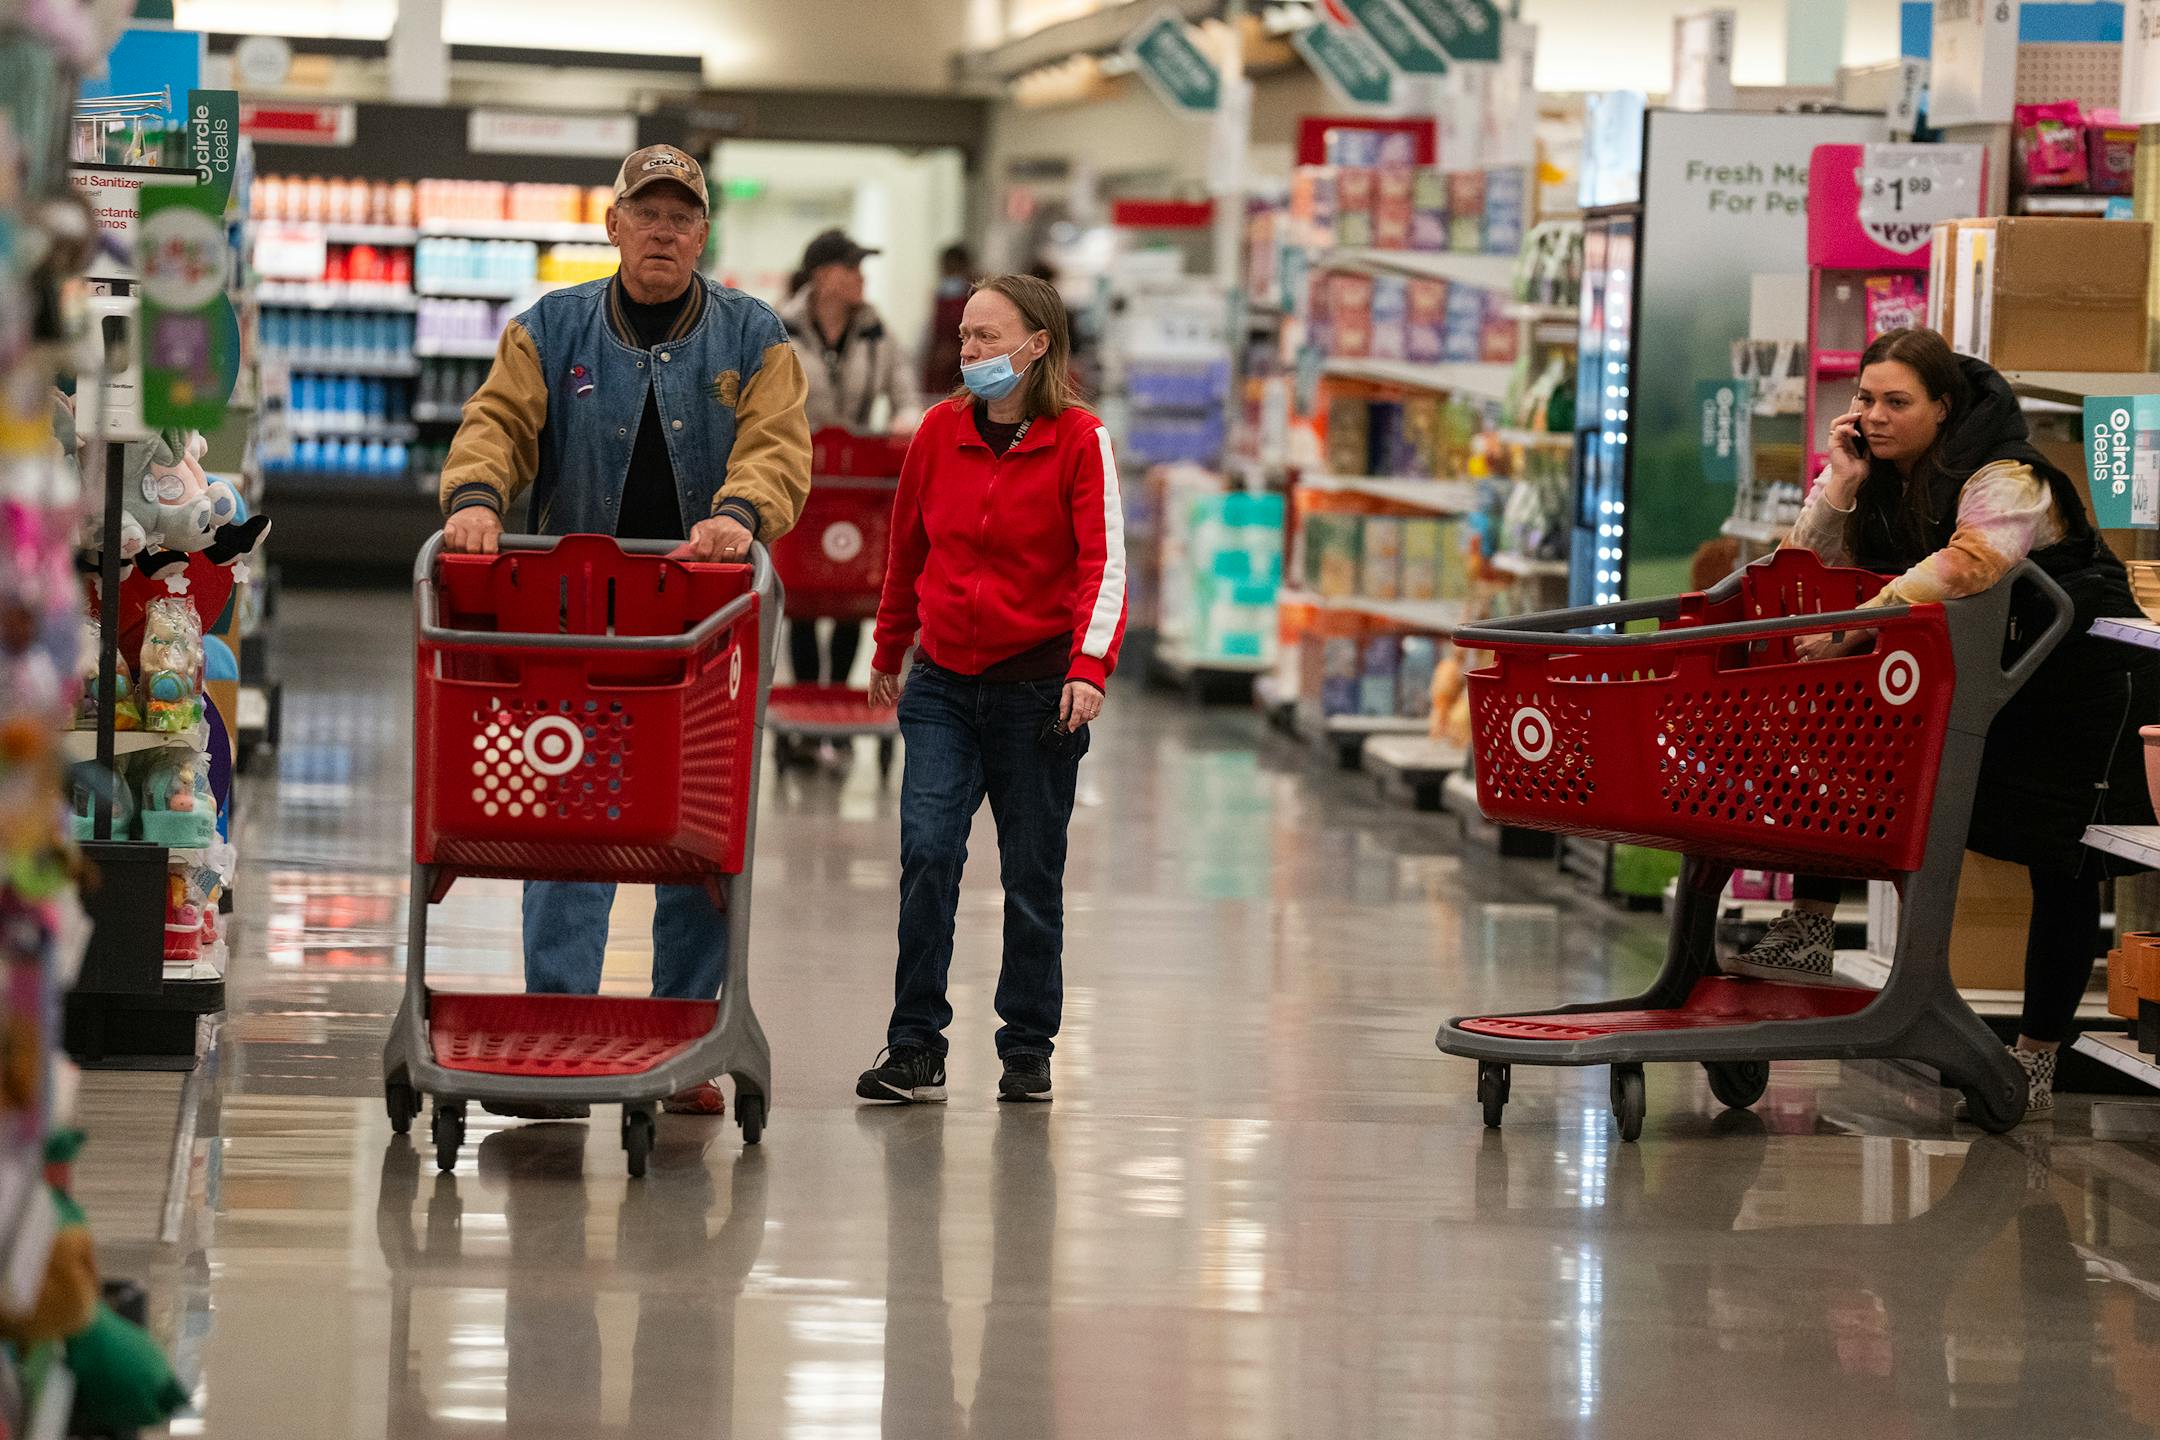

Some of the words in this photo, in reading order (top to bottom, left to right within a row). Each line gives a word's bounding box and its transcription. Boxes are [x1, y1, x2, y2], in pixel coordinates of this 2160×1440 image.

[211, 118, 230, 173] deals
[90, 175, 144, 189] Sanitizer
[1685, 159, 1764, 184] Fresh
[90, 207, 141, 219] ectante
[1708, 189, 1756, 214] For
[97, 219, 127, 229] anos
[1016, 418, 1032, 440] PINK
[2093, 423, 2112, 481] deals
